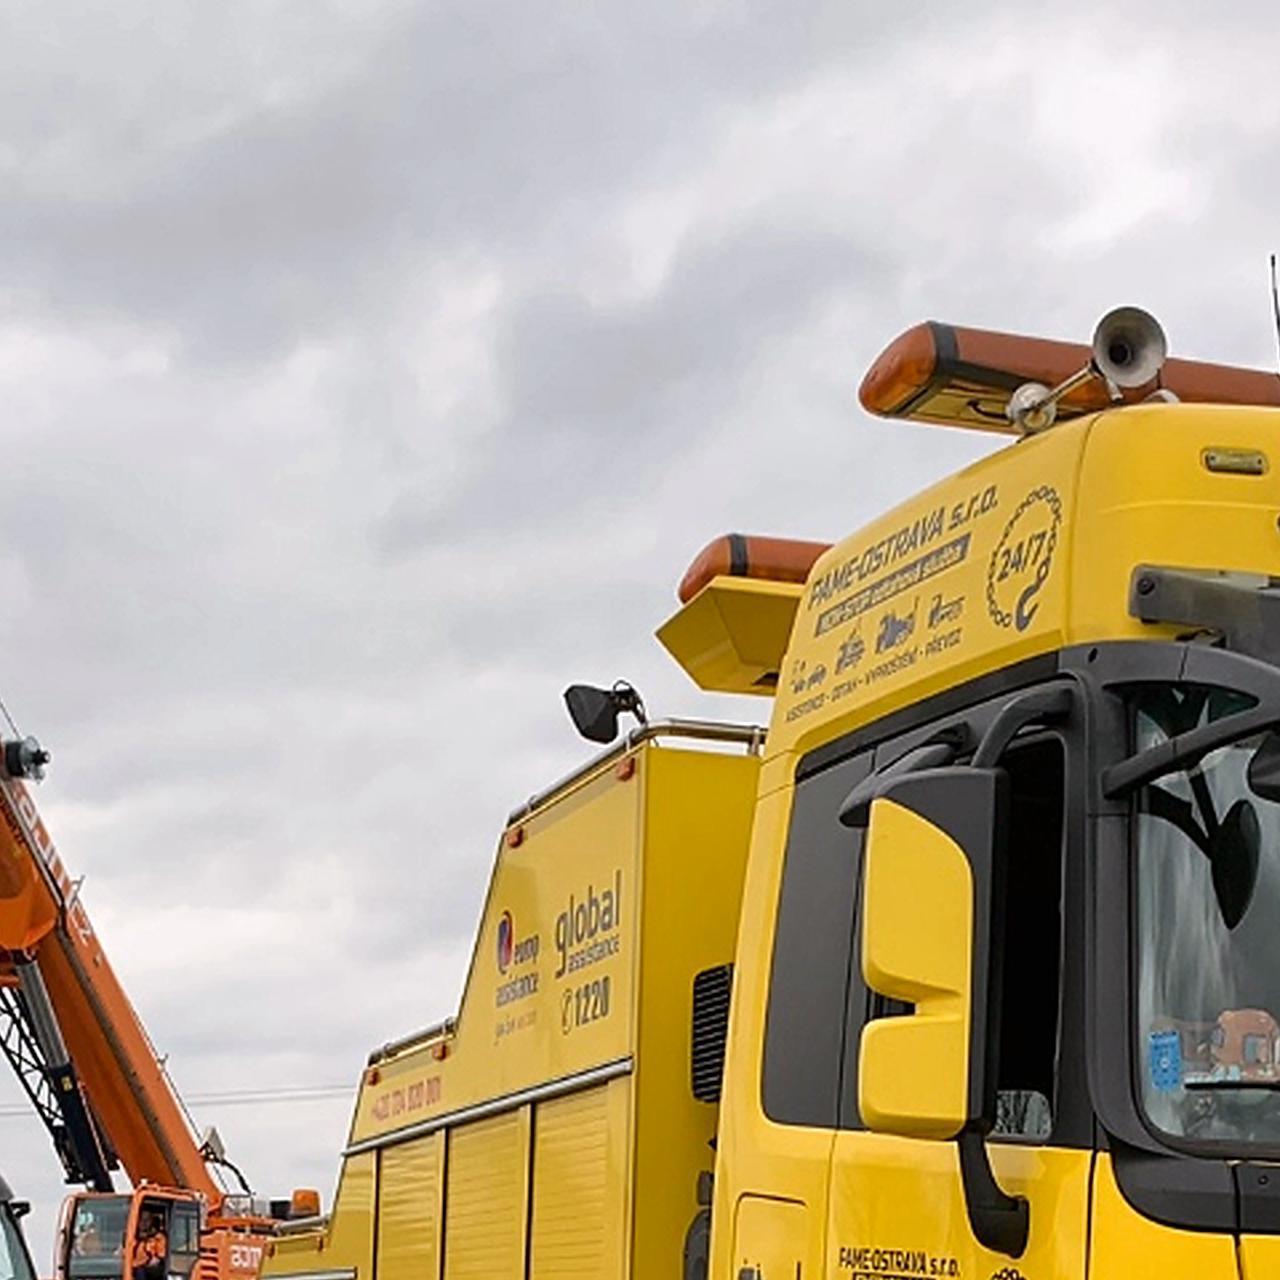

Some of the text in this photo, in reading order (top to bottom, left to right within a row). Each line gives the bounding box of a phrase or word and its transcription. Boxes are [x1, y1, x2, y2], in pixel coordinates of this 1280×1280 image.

[808, 505, 946, 608] PAME-OSTRAVA
[998, 529, 1049, 583] 24/7
[555, 868, 622, 980] global
[569, 935, 620, 973] assistance
